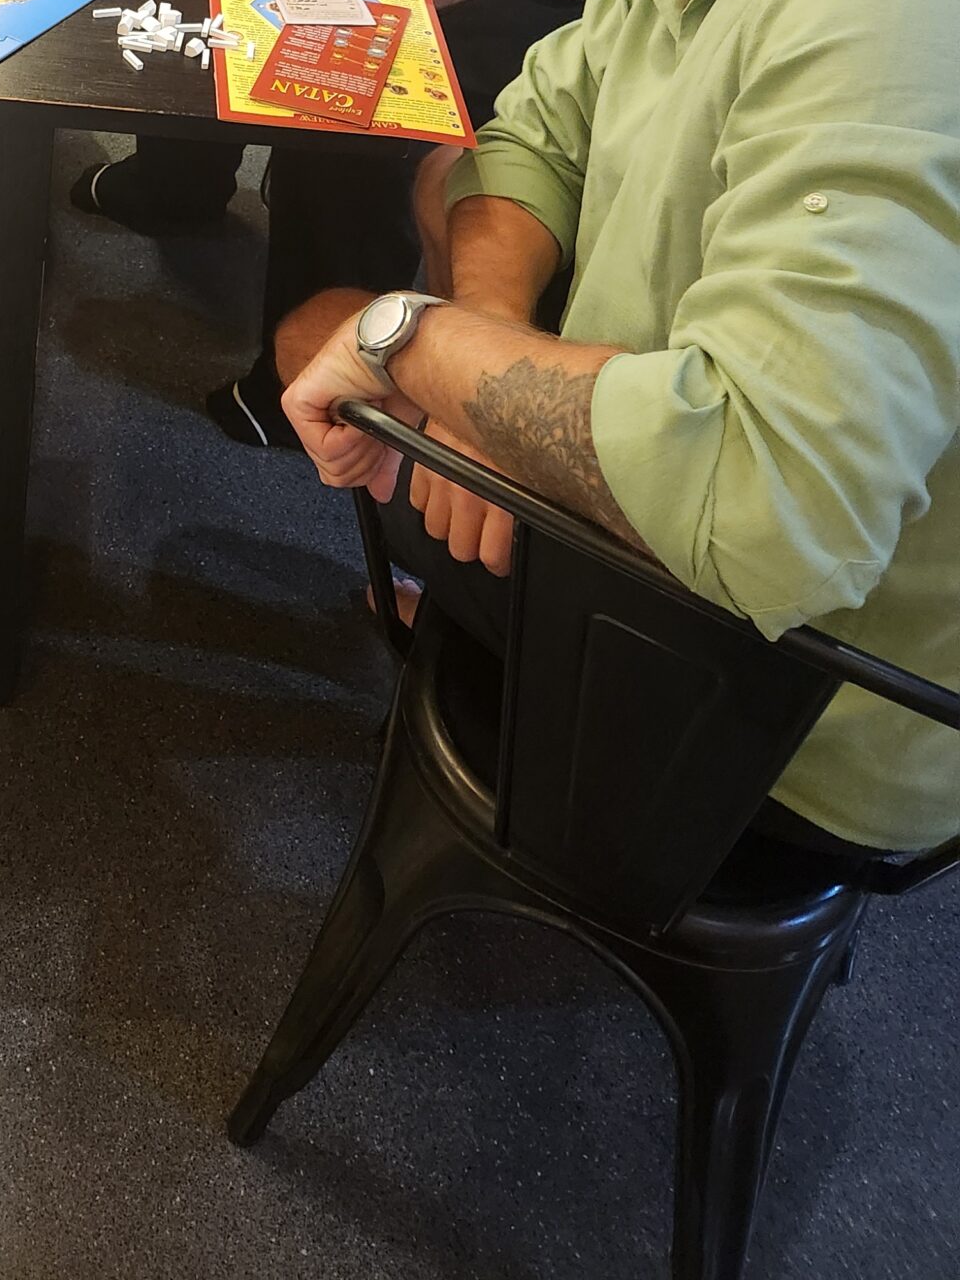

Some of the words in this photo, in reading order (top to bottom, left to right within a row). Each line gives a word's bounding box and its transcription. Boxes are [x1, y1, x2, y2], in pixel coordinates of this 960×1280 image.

[271, 79, 354, 108] CATAN
[328, 106, 363, 116] Explore
[371, 121, 398, 130] GAM
